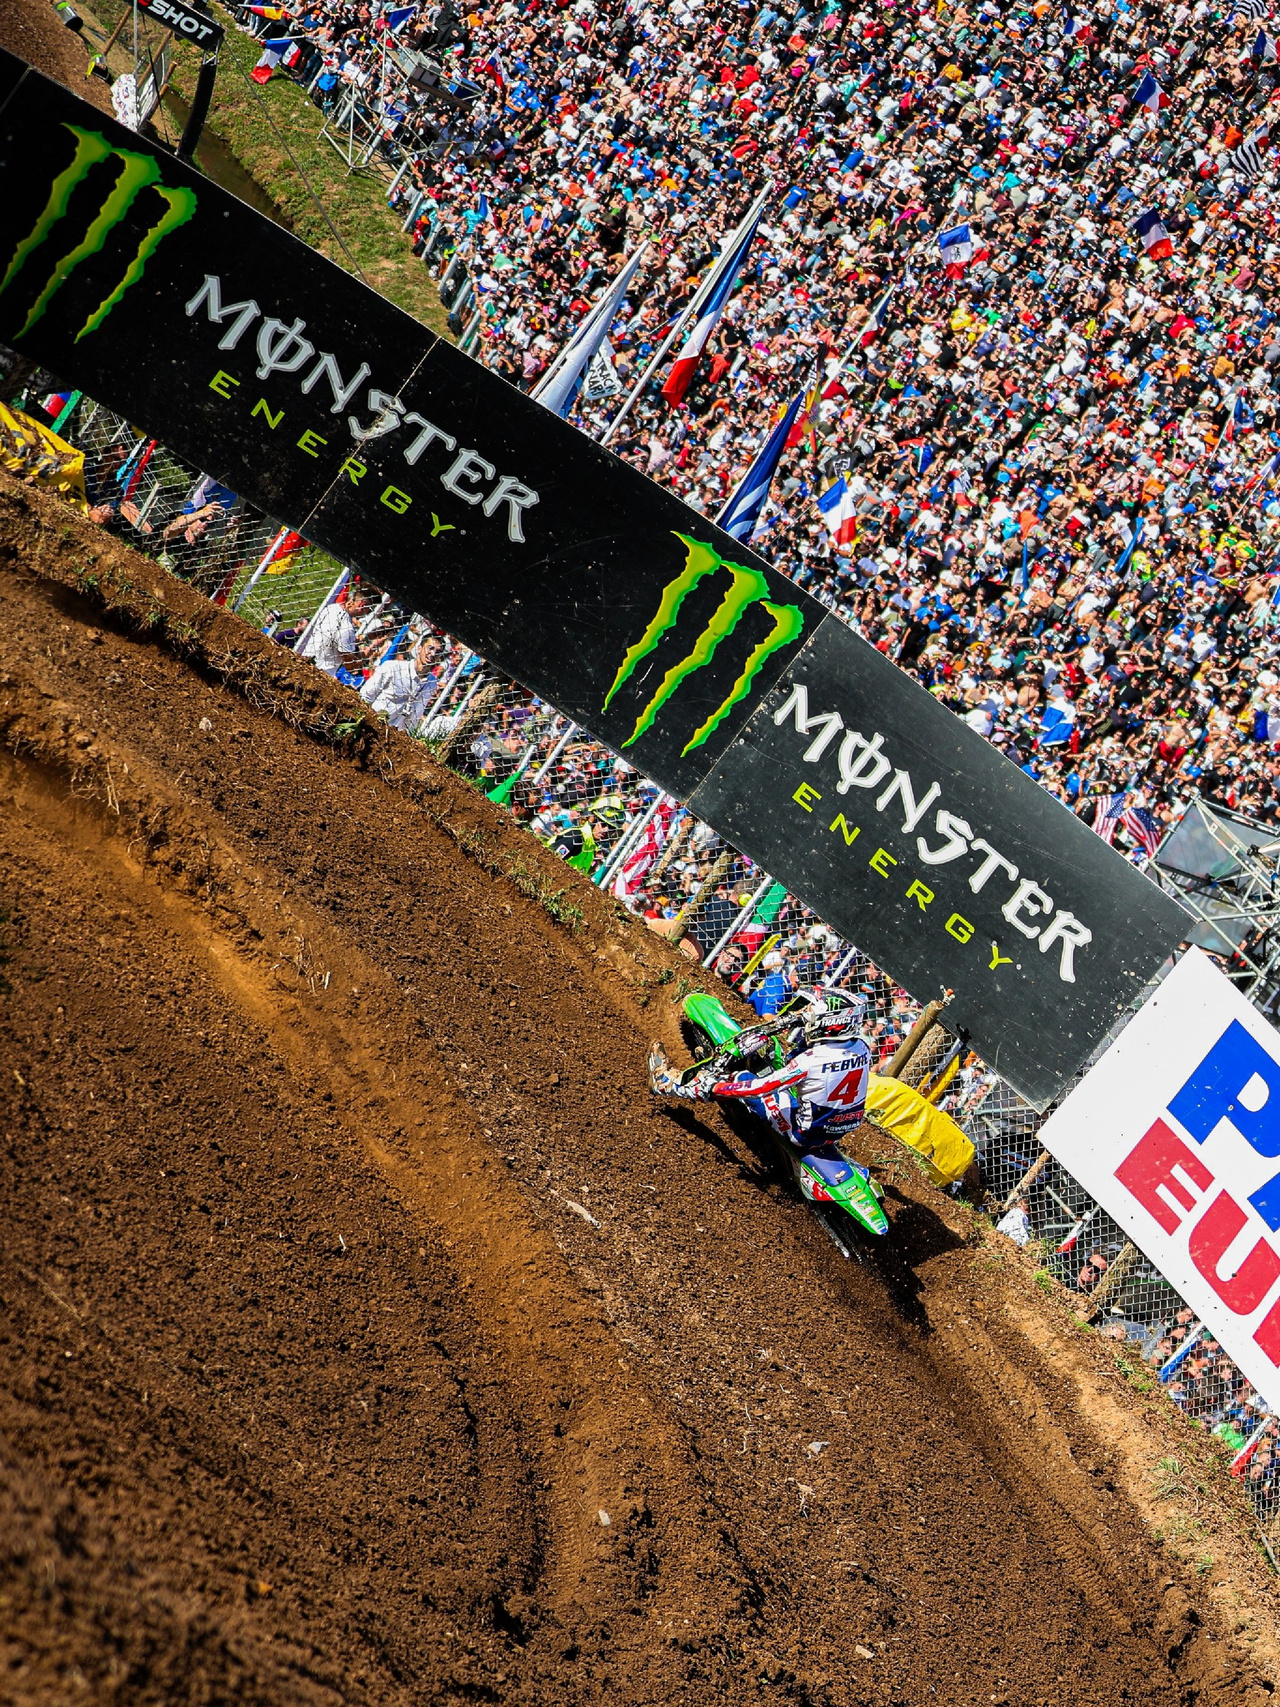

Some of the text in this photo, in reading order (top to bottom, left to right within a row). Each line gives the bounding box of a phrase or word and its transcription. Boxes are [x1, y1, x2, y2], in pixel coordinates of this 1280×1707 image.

[147, 0, 213, 40] SHOT
[185, 274, 540, 543] MONSTER
[208, 369, 455, 538] ENERGY
[774, 683, 1093, 984] MONSTER
[791, 782, 1014, 970] ENERGY
[827, 1068, 864, 1106] 4
